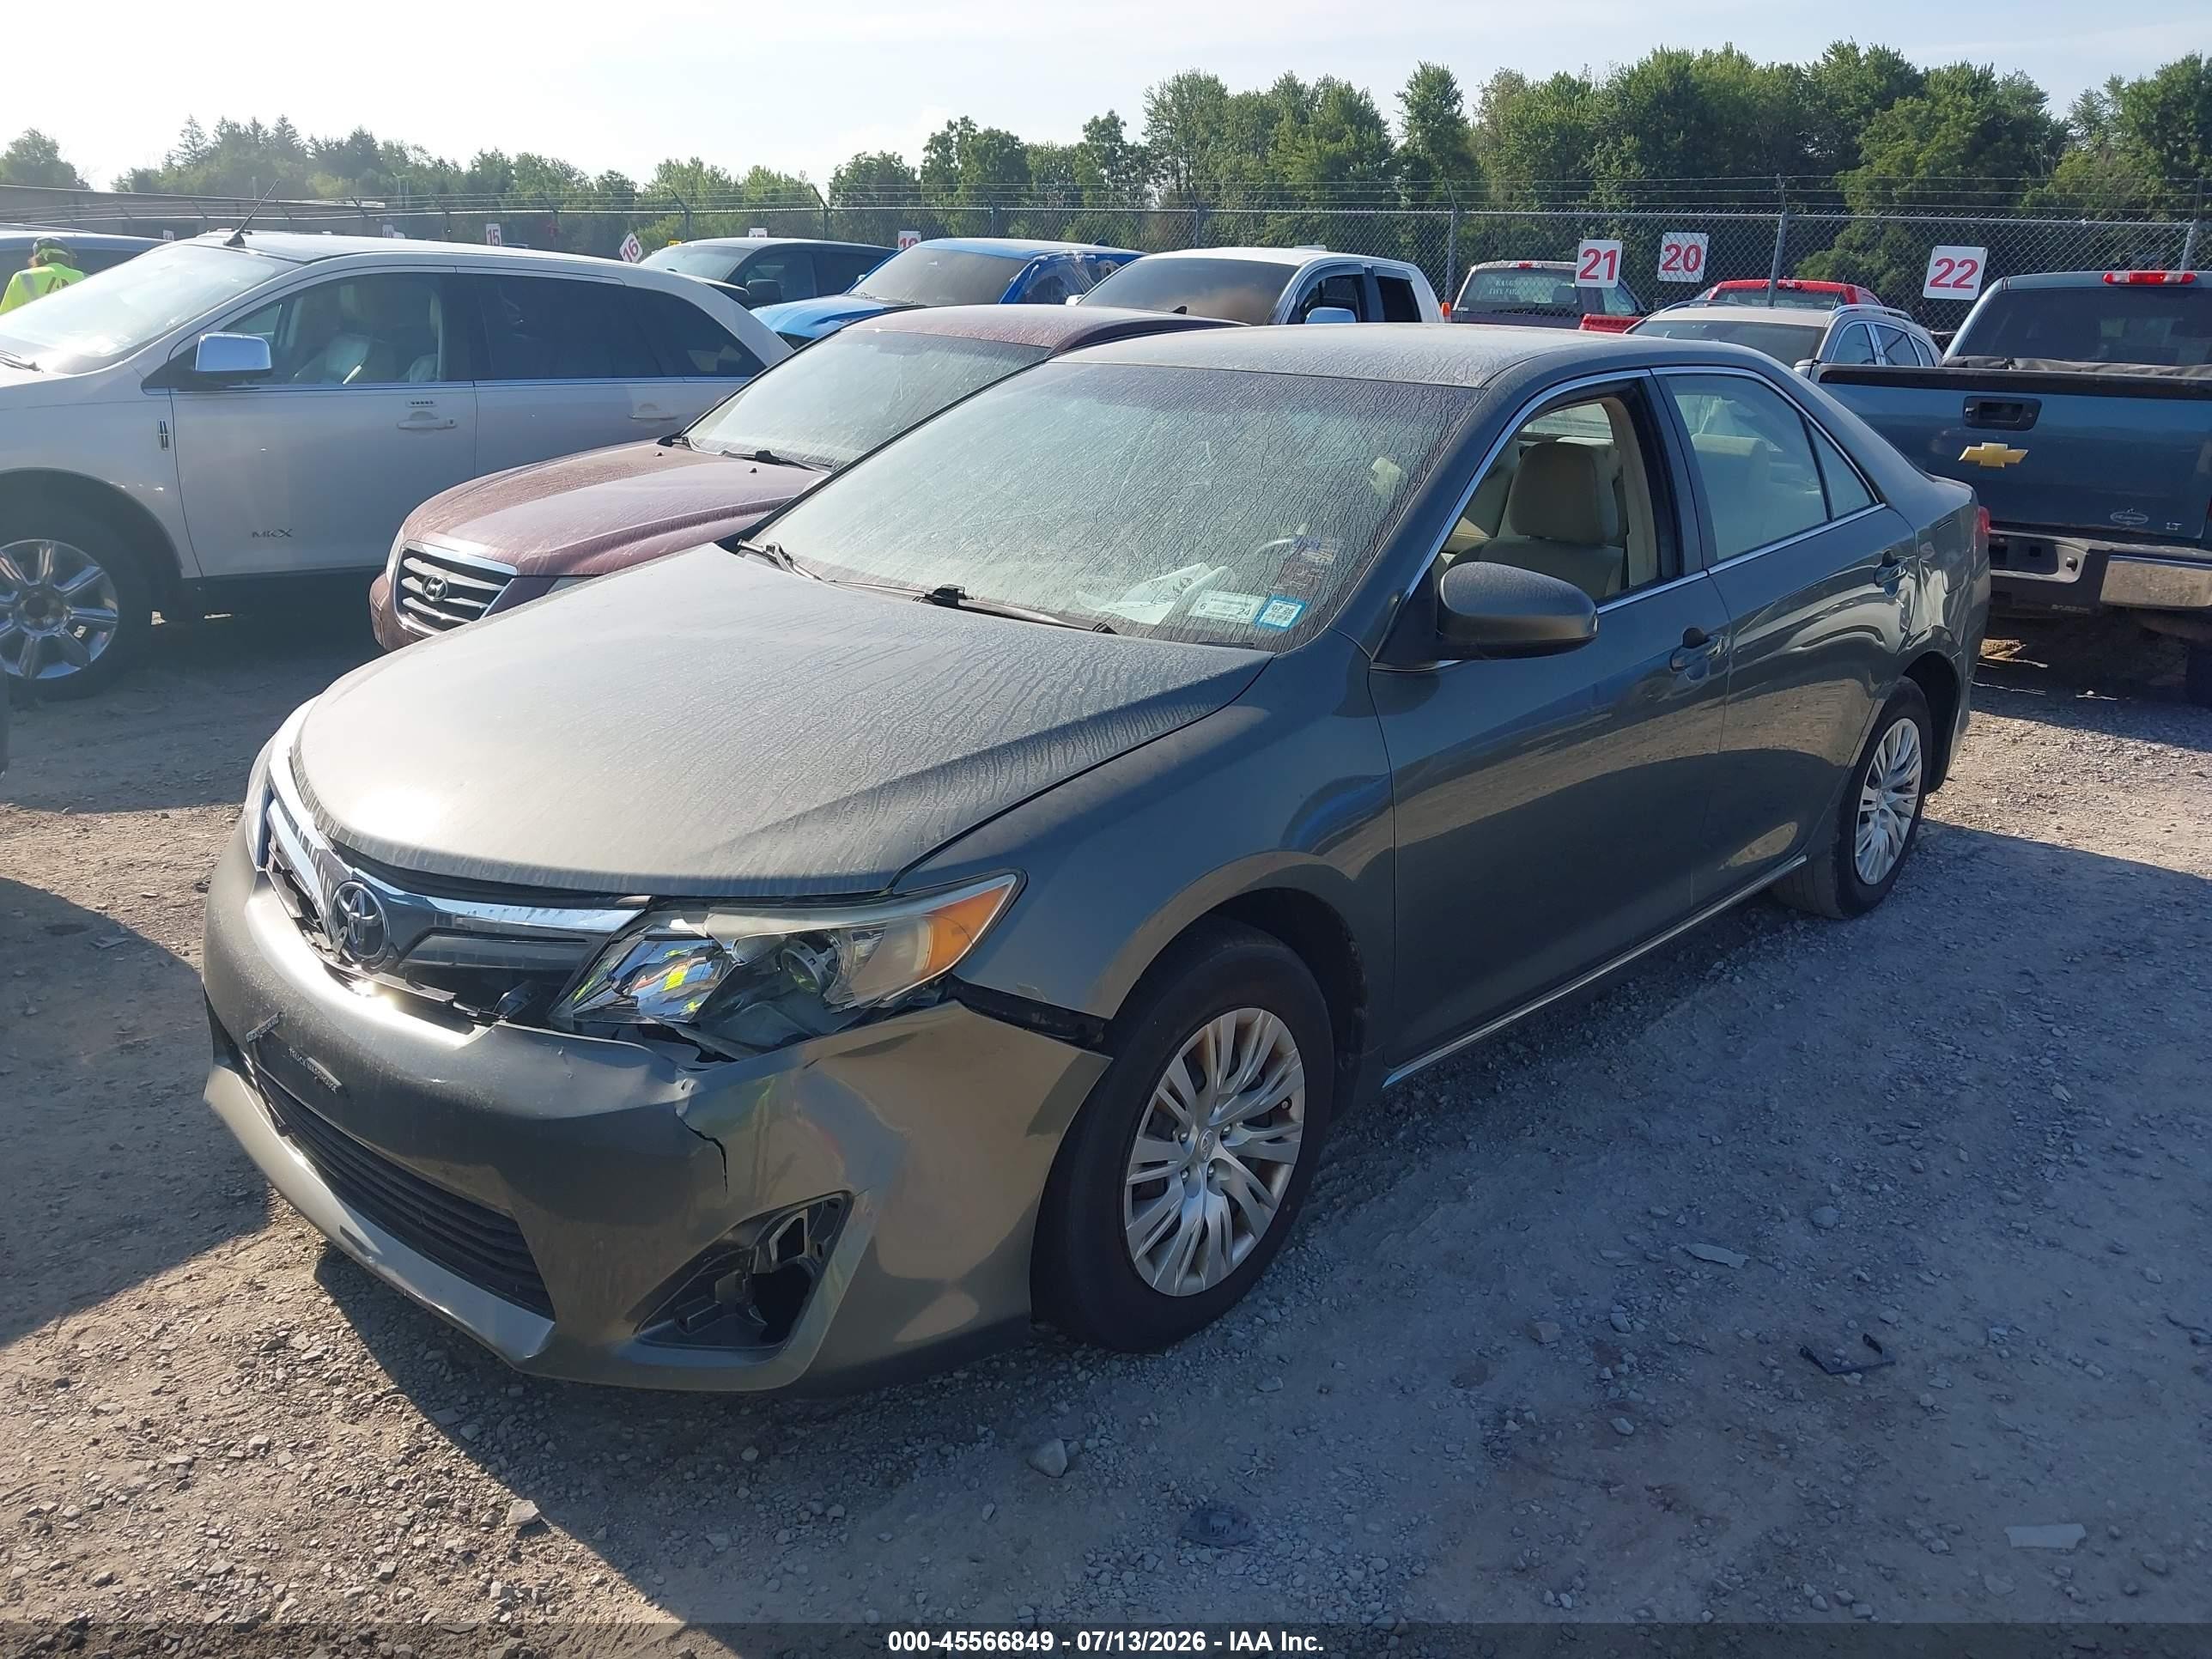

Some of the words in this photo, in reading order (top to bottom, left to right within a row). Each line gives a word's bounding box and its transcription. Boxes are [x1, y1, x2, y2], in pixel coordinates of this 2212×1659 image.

[623, 239, 639, 262] 16
[1578, 248, 1618, 281] 21
[1662, 244, 1702, 273] 20
[1929, 258, 1978, 289] 22
[252, 528, 294, 538] MKX
